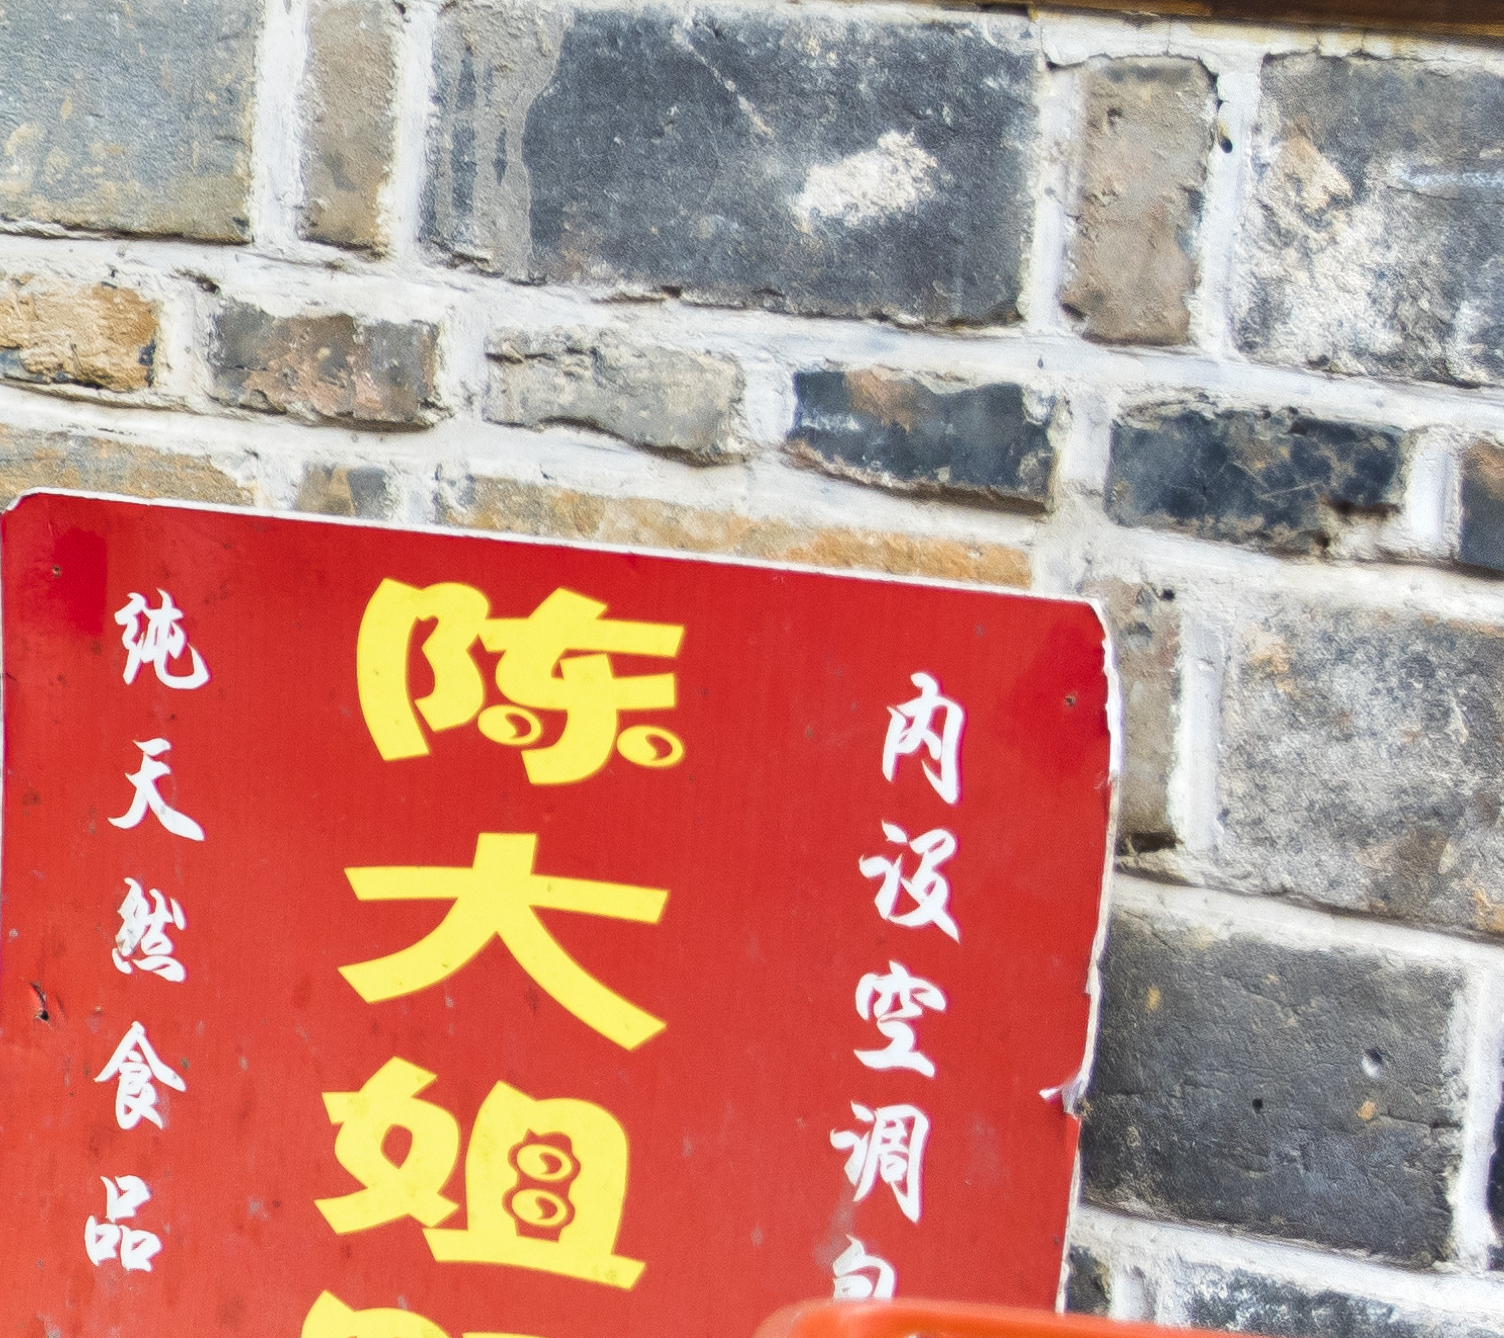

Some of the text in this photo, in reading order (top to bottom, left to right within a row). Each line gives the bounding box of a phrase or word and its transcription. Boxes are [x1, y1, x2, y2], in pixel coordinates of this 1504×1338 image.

[85, 589, 210, 1273] 纯天然食品
